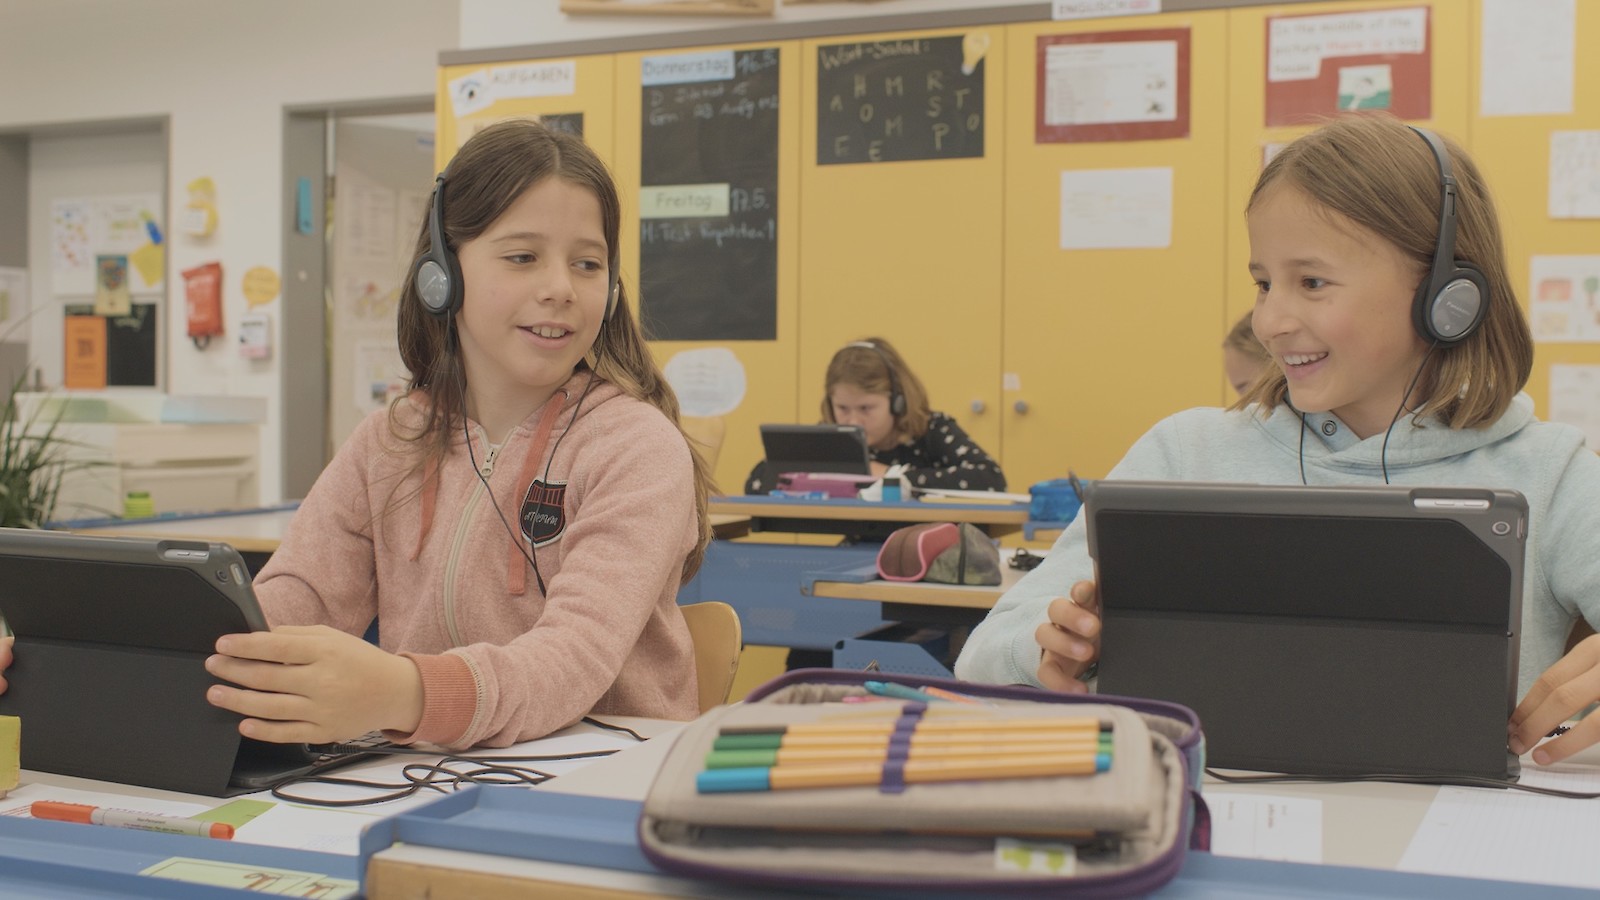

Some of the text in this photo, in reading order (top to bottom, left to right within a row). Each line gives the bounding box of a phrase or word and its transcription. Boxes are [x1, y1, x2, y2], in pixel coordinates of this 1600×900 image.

[1294, 22, 1316, 33] the
[1320, 19, 1364, 32] middle
[1390, 17, 1411, 28] the
[1275, 43, 1321, 55] picture
[493, 65, 570, 83] AUFGABEN
[643, 58, 731, 77] Donnerstag
[854, 73, 867, 99] H
[885, 75, 904, 97] M
[926, 69, 944, 91] R
[830, 93, 843, 113] A
[926, 95, 943, 118] S
[954, 87, 971, 110] T
[859, 103, 874, 123] O
[966, 112, 980, 132] O
[885, 115, 904, 137] M
[931, 122, 950, 150] P
[868, 139, 883, 162] E
[655, 191, 713, 212] Freitag
